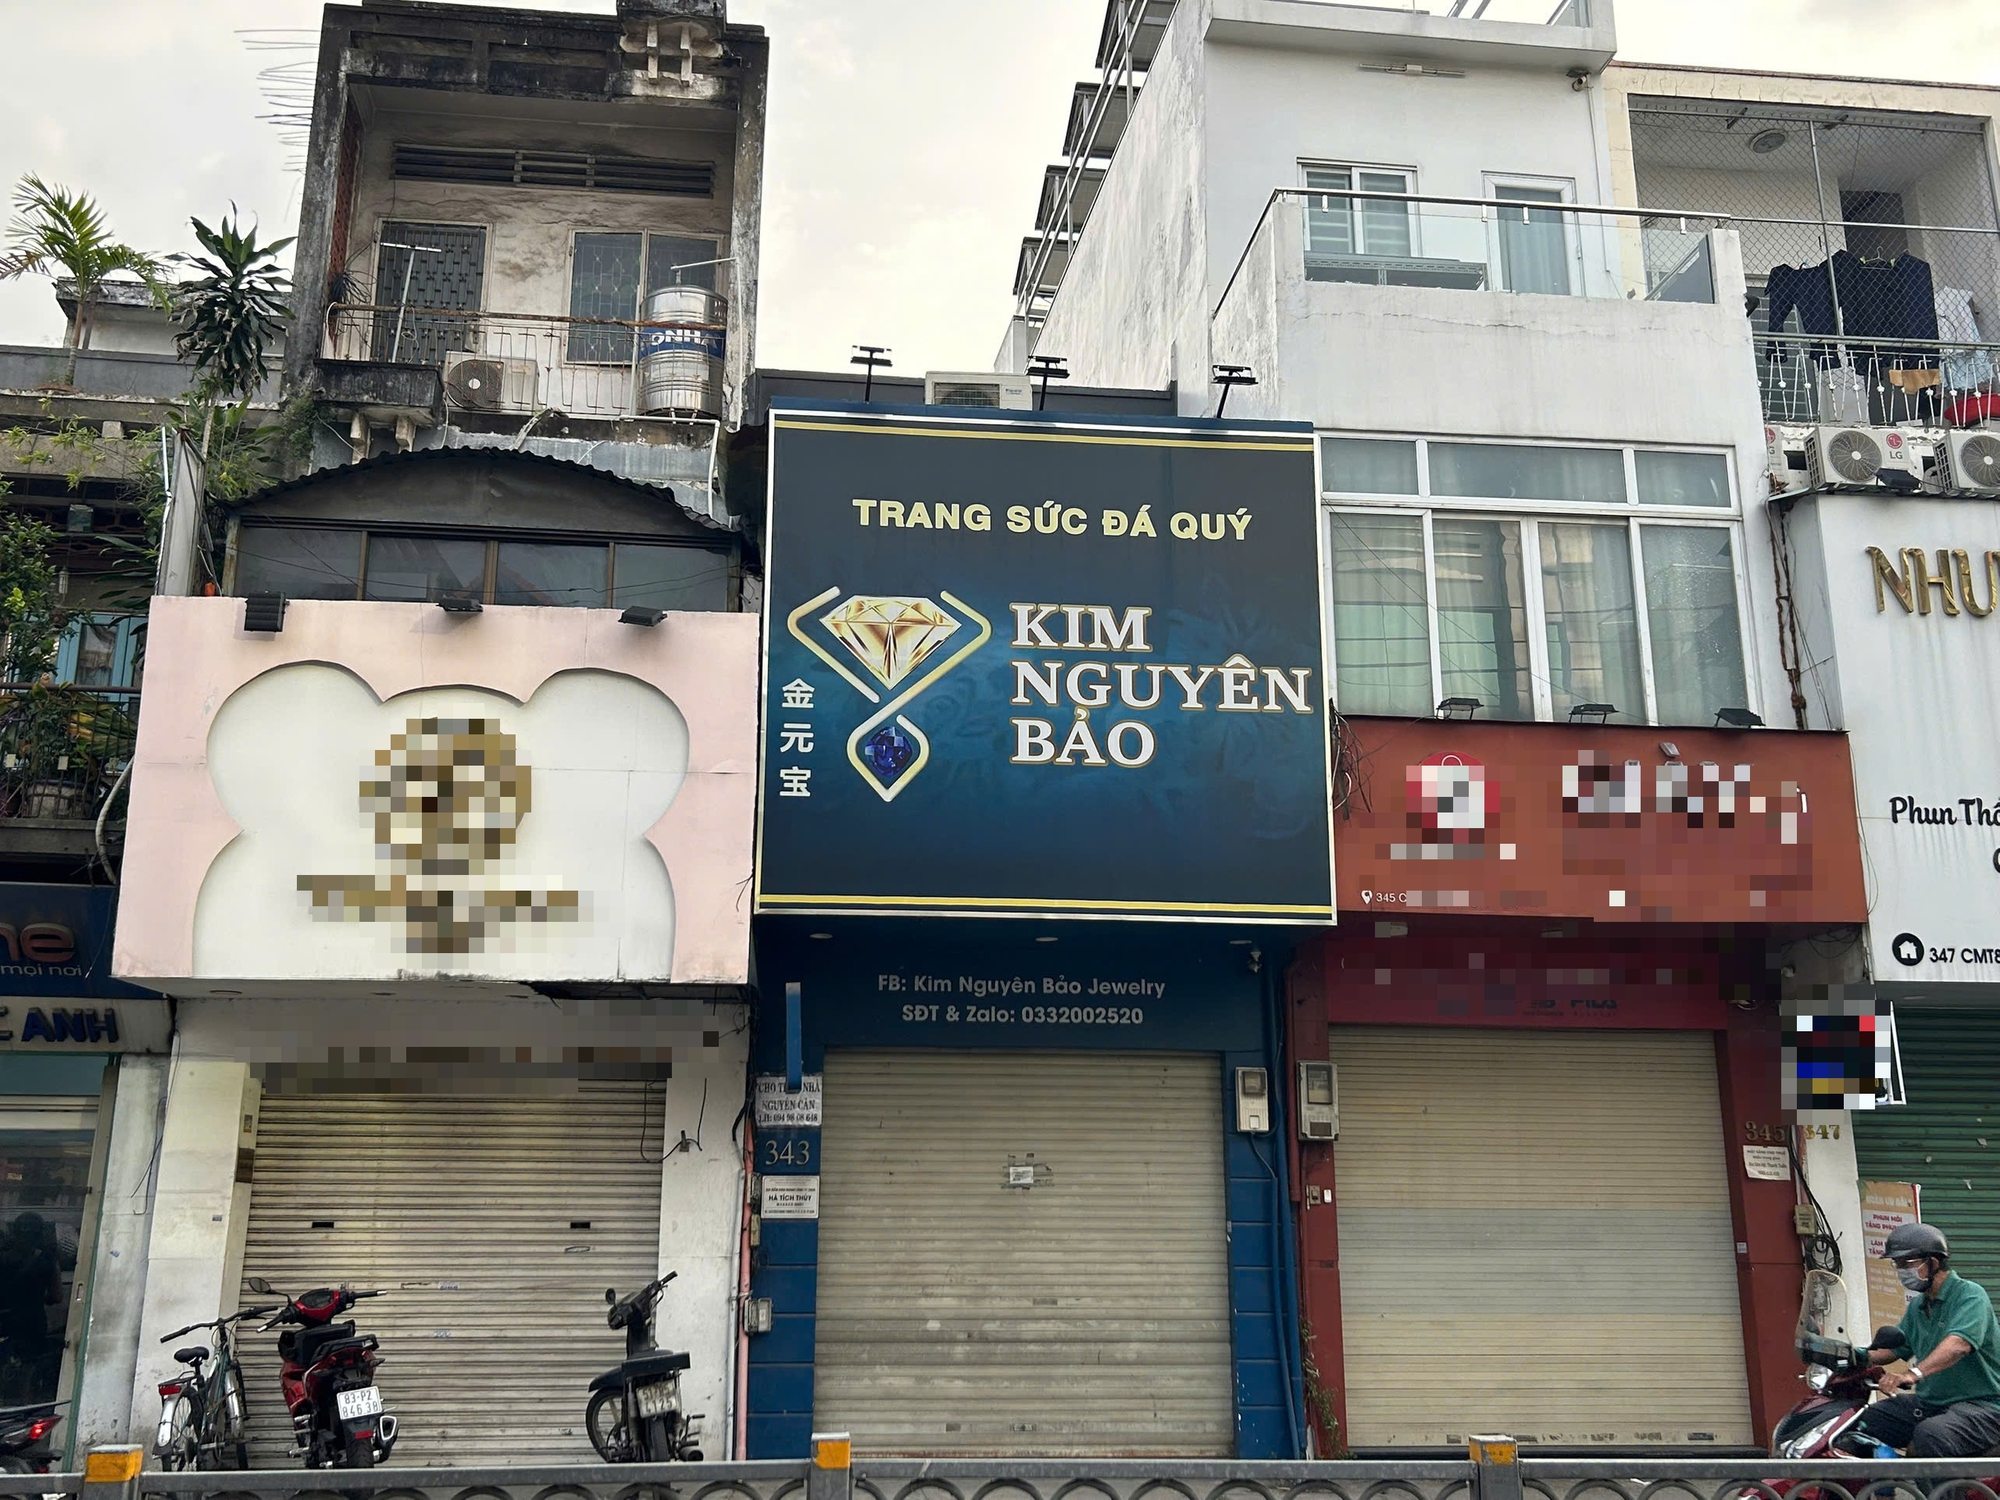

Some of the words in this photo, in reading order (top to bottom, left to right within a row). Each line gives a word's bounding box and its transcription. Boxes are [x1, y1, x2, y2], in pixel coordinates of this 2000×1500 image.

[1889, 451, 1903, 459] LG
[852, 499, 991, 531] TRANG
[1006, 500, 1088, 535] SỨC
[1102, 504, 1157, 538] ĐÁ
[1170, 507, 1252, 541] QUÝ
[1865, 546, 2000, 617] NHU
[1009, 602, 1153, 652] KIM
[1010, 653, 1313, 713] NGUYÊN
[779, 677, 815, 798] 金元宝
[1010, 707, 1156, 767] BẢO
[1889, 796, 1957, 825] Phun
[1376, 892, 1396, 903] 345
[1929, 947, 1955, 963] 347
[0, 963, 43, 977] mọi
[49, 964, 82, 976] nơi
[878, 974, 906, 991] FB:
[914, 975, 951, 992] Kim
[959, 976, 1035, 997] Nguyên
[1043, 975, 1081, 994] Bảo
[1087, 978, 1165, 998] Jewelry
[21, 1007, 119, 1043] ANH
[902, 1004, 939, 1021] SĐT
[946, 1006, 960, 1022] &
[966, 1005, 1015, 1023] Zalo:
[1021, 1007, 1143, 1024] 0332002520
[758, 1082, 776, 1093] CHO
[1745, 1121, 1786, 1141] 345
[765, 1140, 810, 1165] 343
